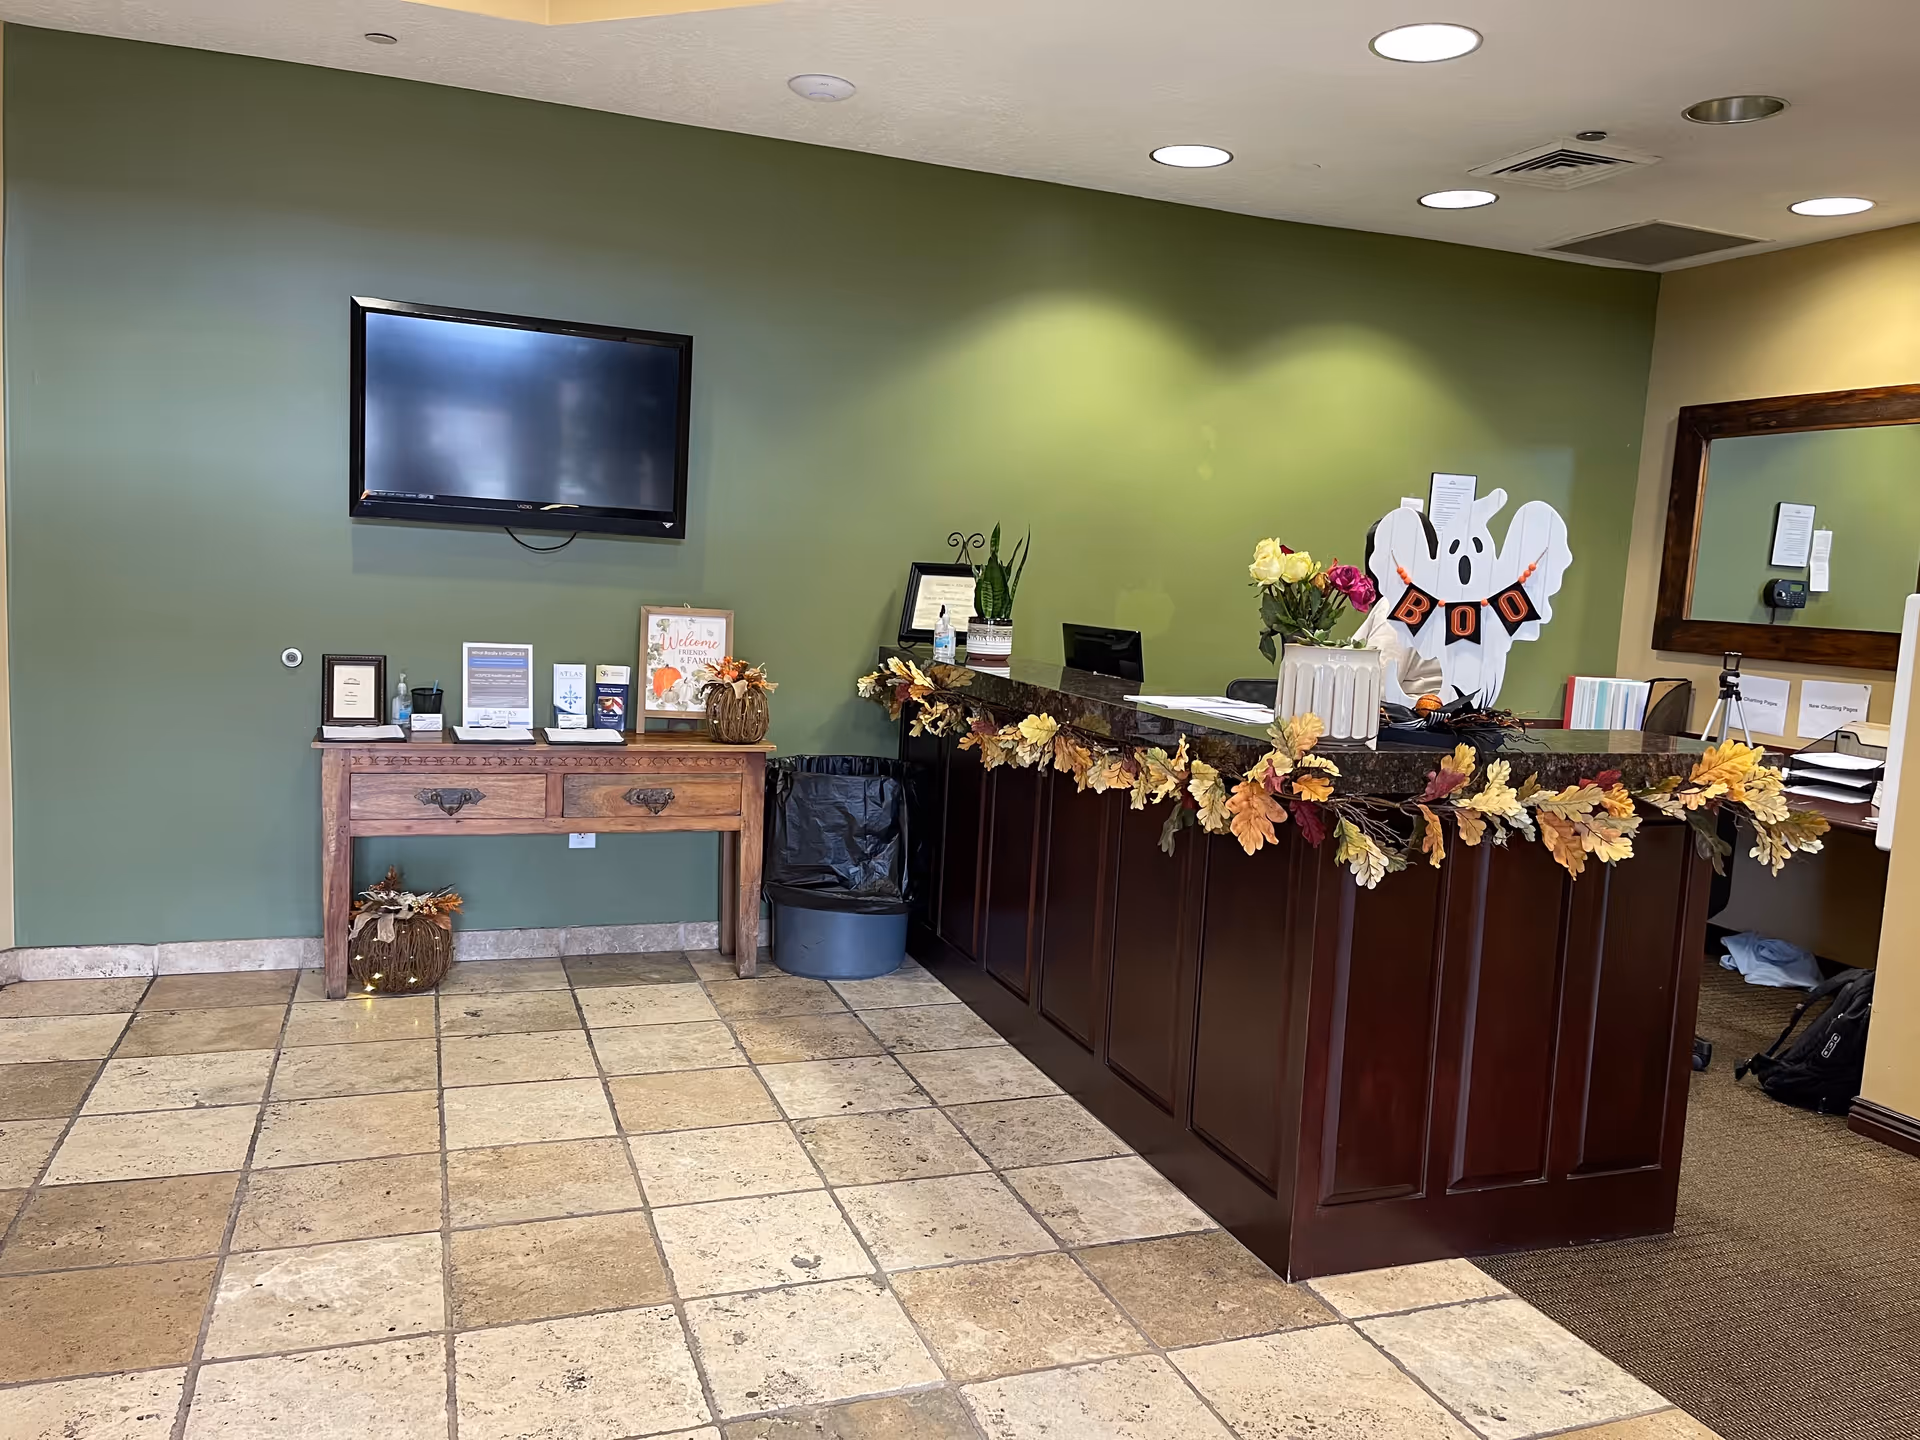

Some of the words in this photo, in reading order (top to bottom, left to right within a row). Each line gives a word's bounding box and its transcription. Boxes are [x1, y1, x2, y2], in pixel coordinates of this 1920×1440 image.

[1393, 588, 1529, 637] BOO
[660, 630, 721, 652] Welcome
[560, 670, 583, 678] ATLAS
[1743, 696, 1763, 705] Charting
[1763, 699, 1778, 707] Pages
[1820, 704, 1842, 712] Charting
